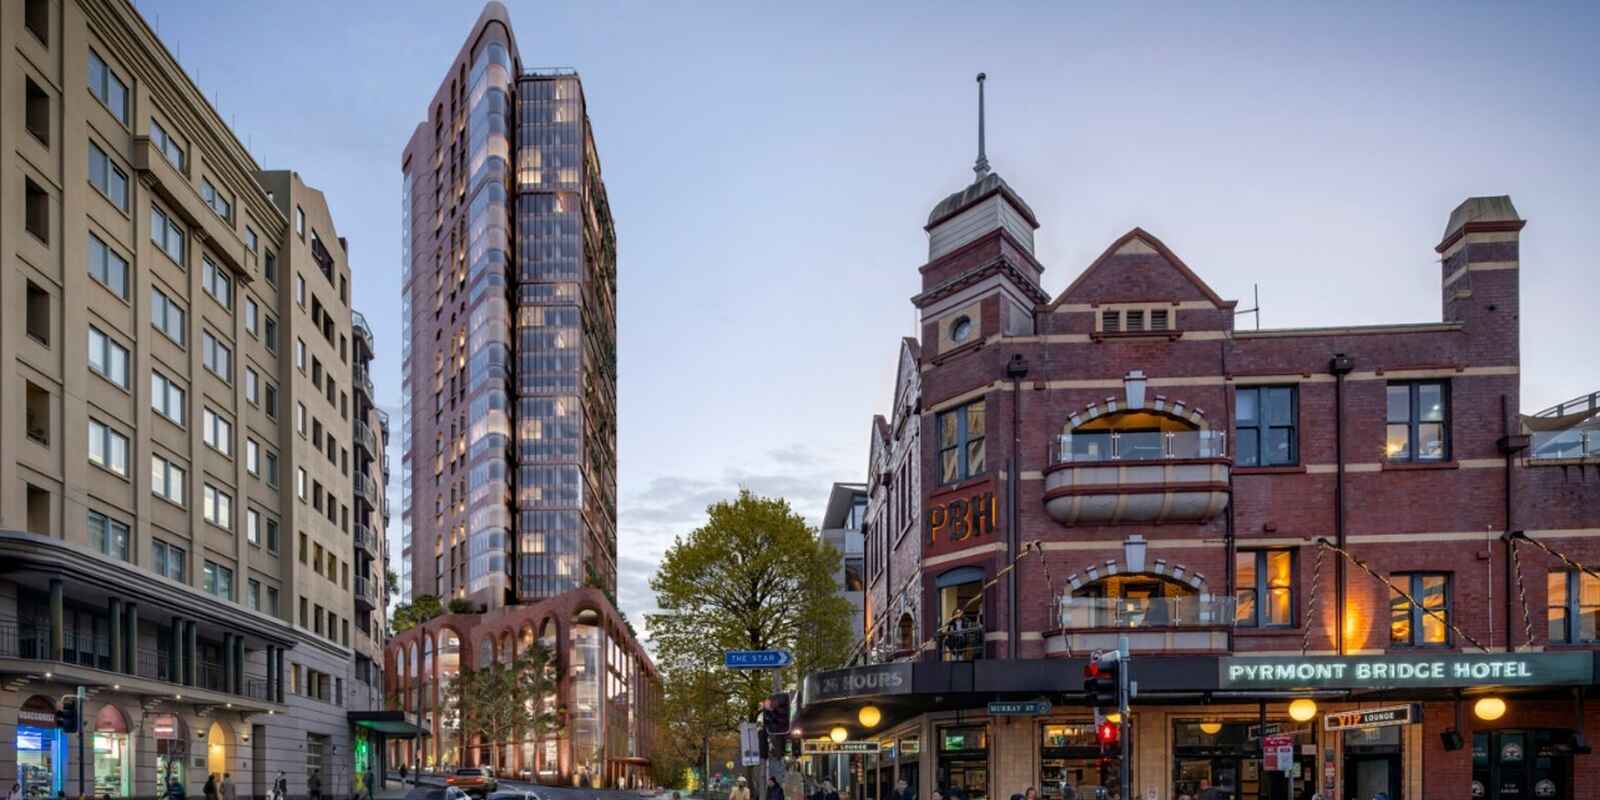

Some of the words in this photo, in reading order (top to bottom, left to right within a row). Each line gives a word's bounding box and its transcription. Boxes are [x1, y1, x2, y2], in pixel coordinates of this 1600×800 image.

[927, 492, 997, 545] PBH
[731, 655, 747, 664] THE
[752, 655, 775, 664] STAR
[1229, 663, 1347, 681] PYRMONT
[1356, 662, 1446, 680] BRIDGE
[1454, 661, 1532, 678] HOTEL
[843, 672, 903, 689] HOURS
[1339, 713, 1362, 728] VIP
[1365, 711, 1395, 723] LOUNGE
